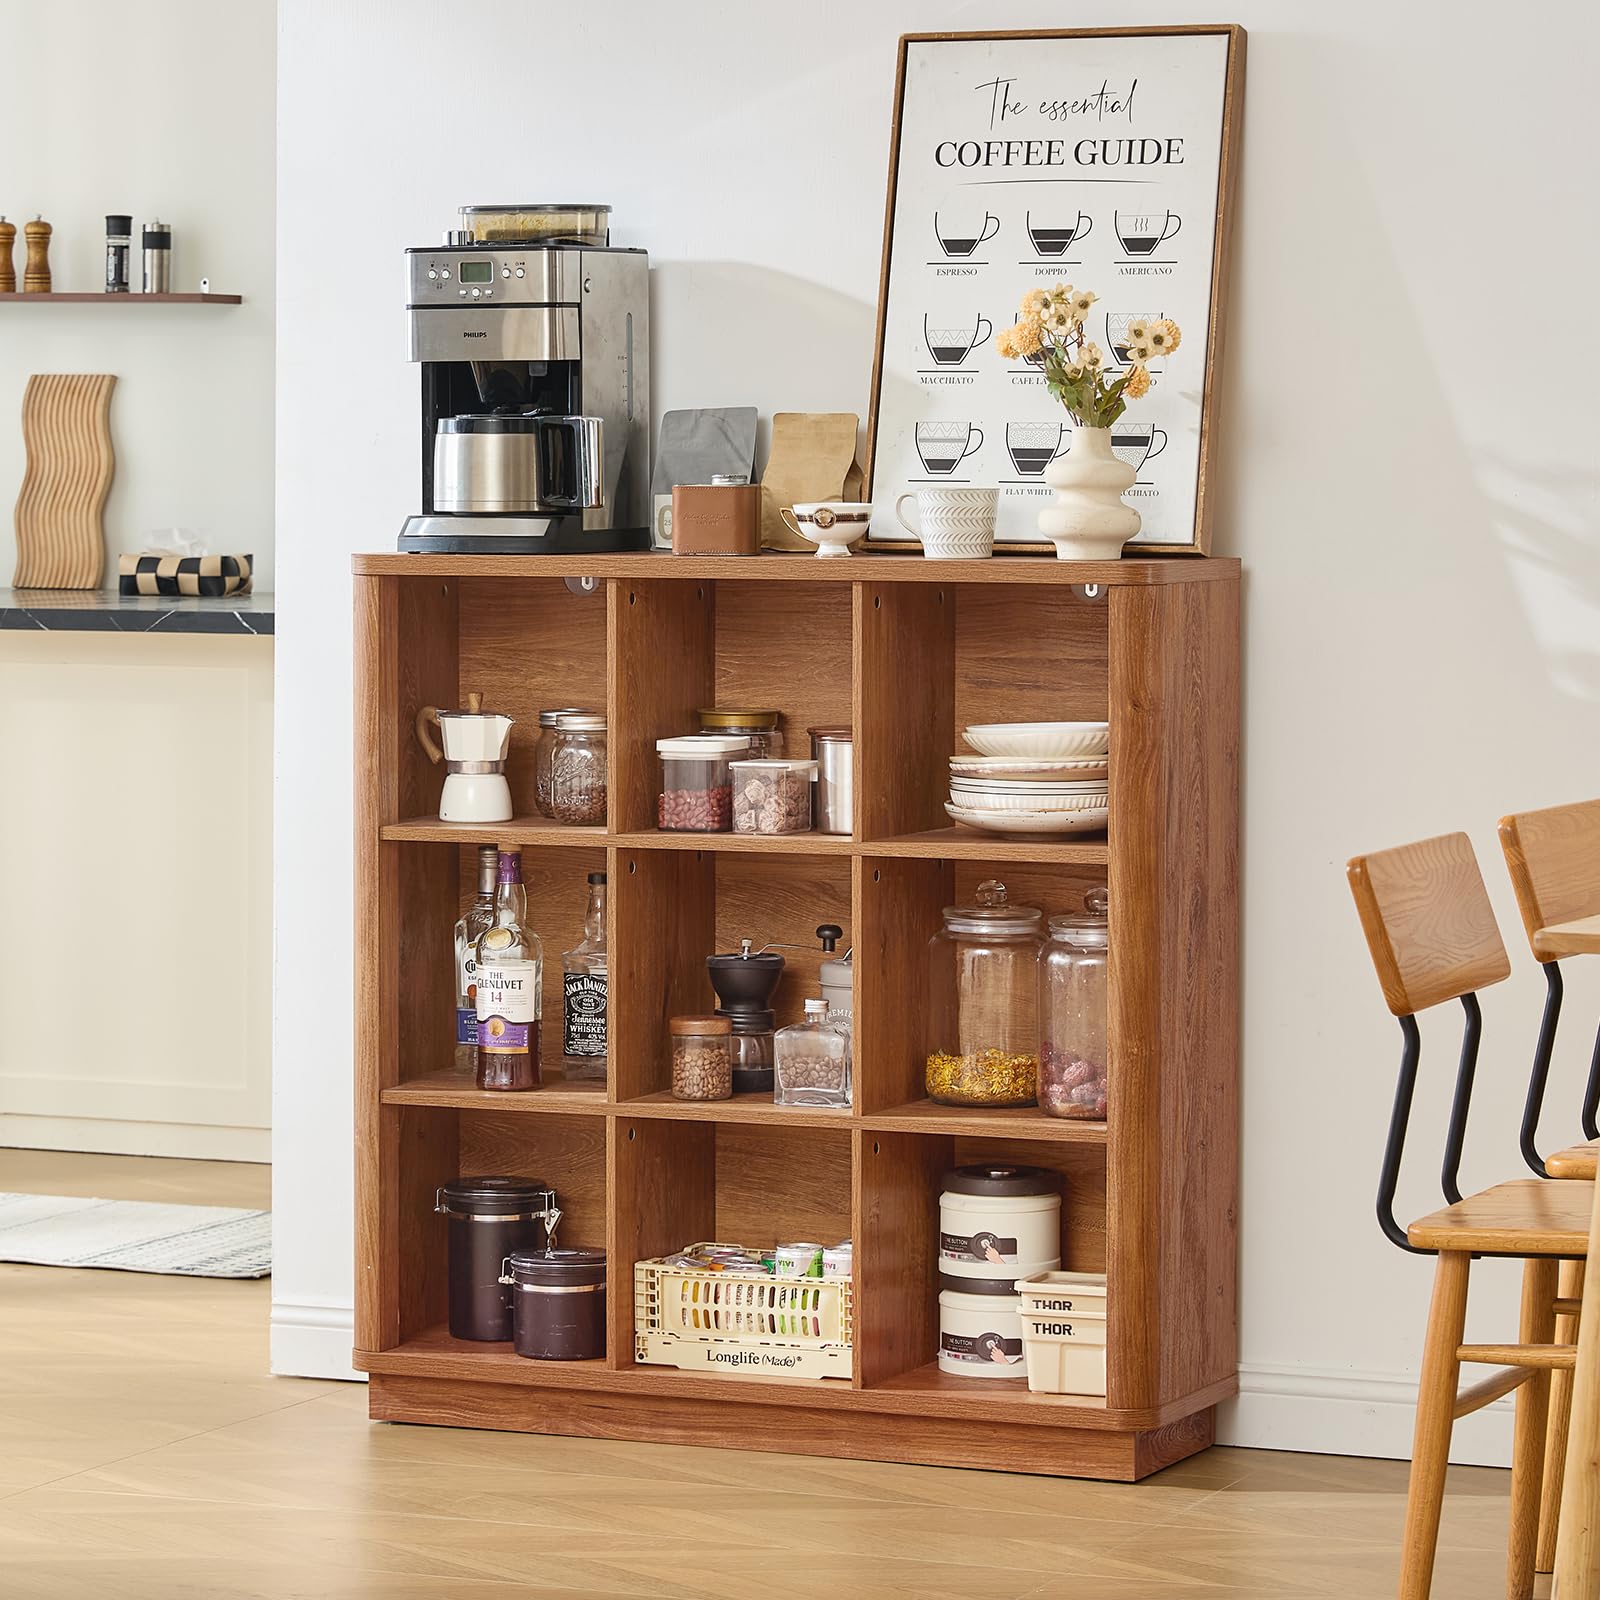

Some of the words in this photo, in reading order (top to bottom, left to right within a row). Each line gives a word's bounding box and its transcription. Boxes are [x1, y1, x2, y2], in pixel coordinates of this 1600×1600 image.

[975, 76, 1028, 131] The
[1039, 79, 1138, 124] essential
[935, 139, 1065, 168] COFFEE
[1074, 138, 1185, 166] GUIDE
[936, 268, 978, 276] ESPRESSO
[1034, 267, 1068, 276] DOPPIO
[1118, 267, 1173, 275] AMERICANO
[463, 331, 488, 339] PHILIPS
[919, 376, 974, 385] MACCHIATO
[1005, 488, 1025, 496] FLAT
[1120, 489, 1160, 497] CCHIATO
[489, 971, 504, 979] THE
[478, 977, 524, 991] GLENLIVET
[565, 981, 583, 996] JACK
[490, 991, 503, 1003] 14
[571, 1012, 606, 1025] Tennessee
[569, 1025, 607, 1034] WHISKEY
[706, 1349, 760, 1366] Longlife
